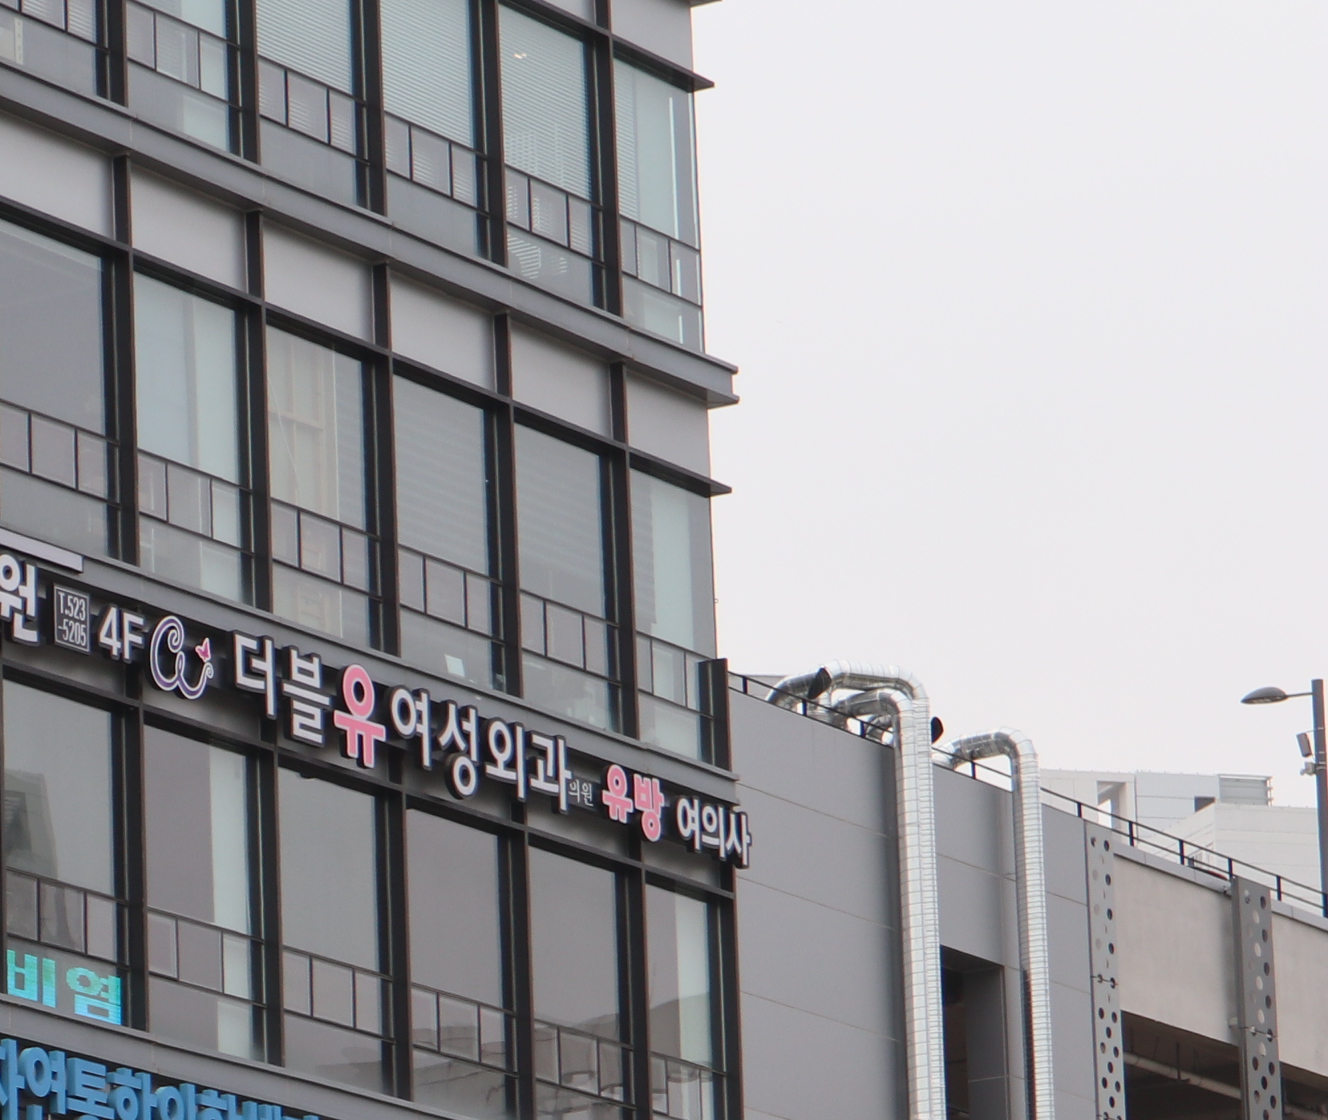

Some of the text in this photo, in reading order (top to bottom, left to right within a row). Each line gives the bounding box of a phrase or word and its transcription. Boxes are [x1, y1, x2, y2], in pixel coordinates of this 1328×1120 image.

[57, 588, 86, 622] T.523
[99, 605, 143, 660] 4F
[569, 779, 594, 806] 의원
[602, 764, 664, 842] 유방
[676, 796, 751, 866] 여의사
[7, 949, 121, 1025] 비염
